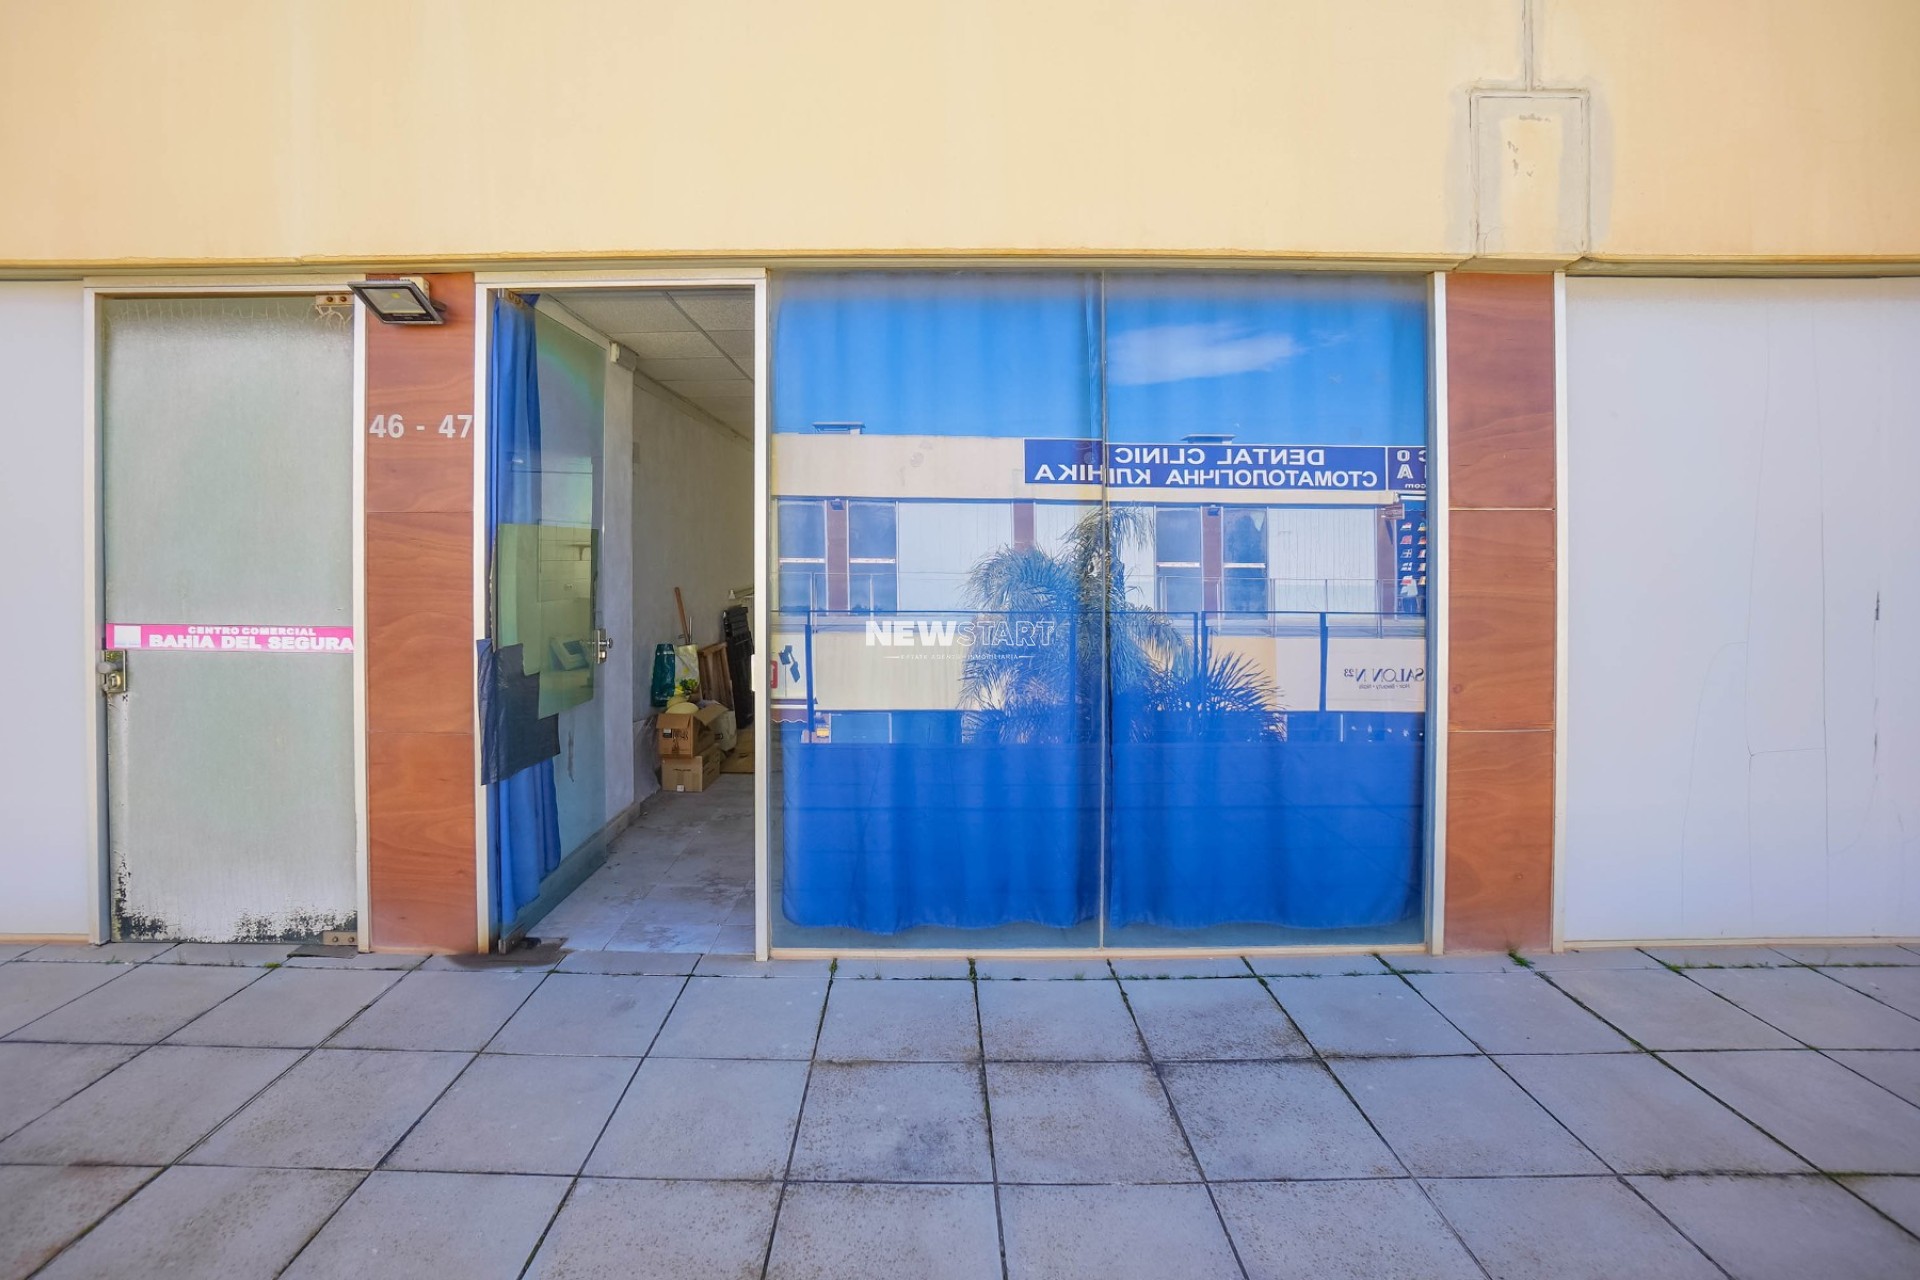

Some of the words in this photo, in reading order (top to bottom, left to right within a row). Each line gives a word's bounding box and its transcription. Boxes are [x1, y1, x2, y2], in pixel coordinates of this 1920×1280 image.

[369, 414, 404, 439] 46
[438, 414, 473, 439] 47
[188, 626, 240, 635] CENTRO
[241, 626, 316, 636] COMERCIAL
[149, 634, 216, 649] BAHIA
[221, 635, 261, 650] DEL
[267, 636, 354, 651] SEGURA
